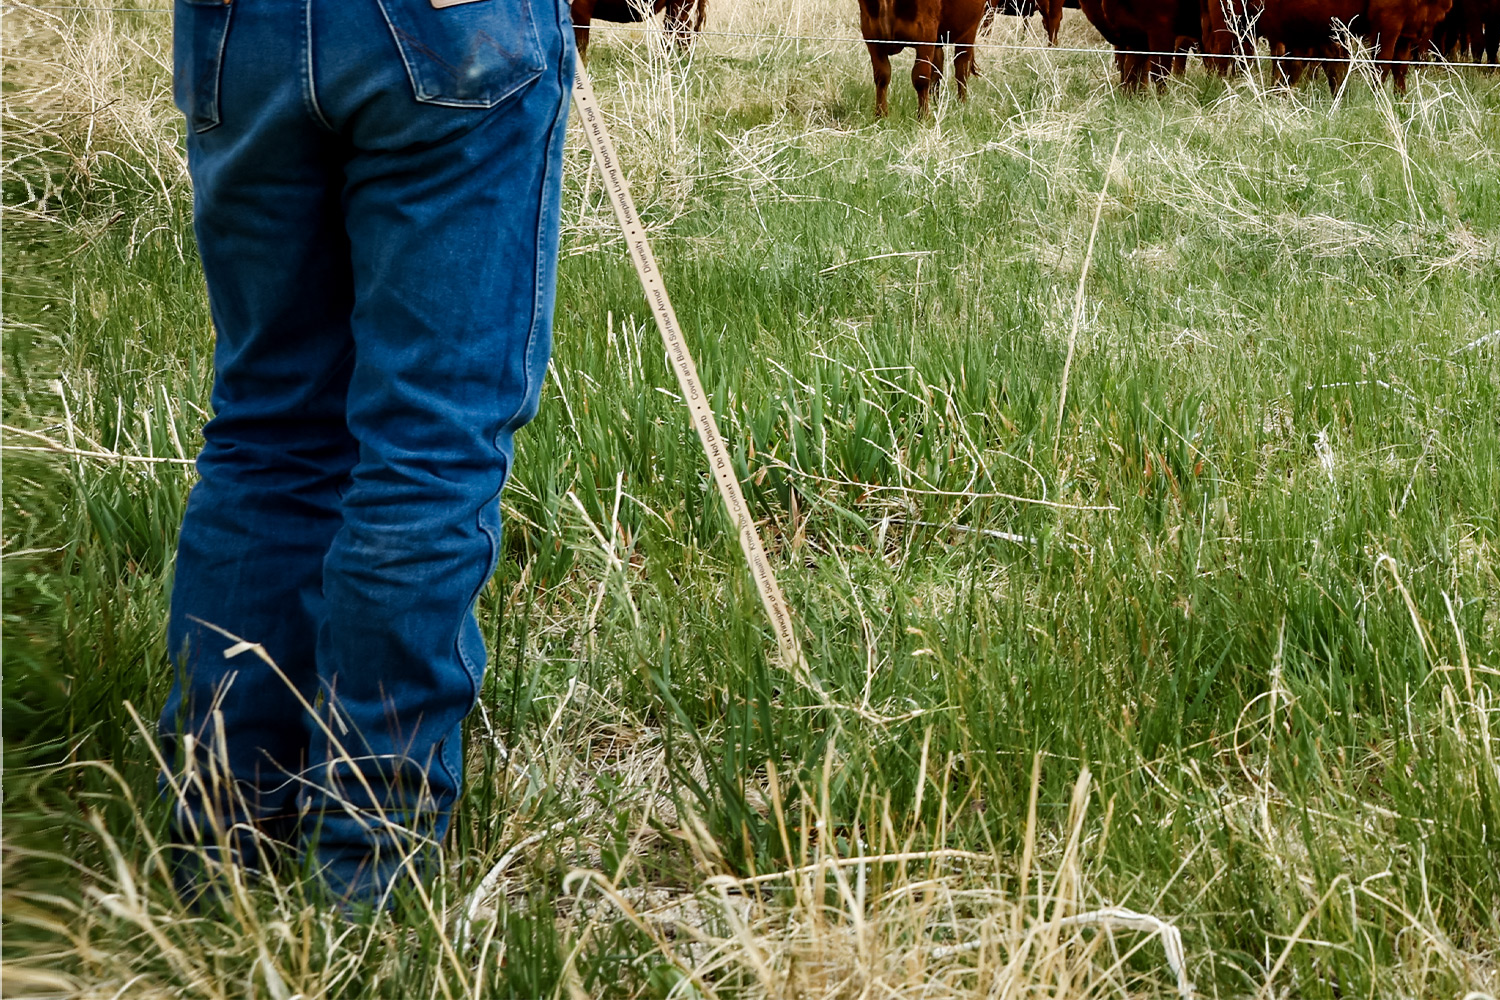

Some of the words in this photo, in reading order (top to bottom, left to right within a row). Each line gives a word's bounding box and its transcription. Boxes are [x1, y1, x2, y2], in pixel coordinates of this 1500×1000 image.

[584, 106, 595, 122] Soil
[591, 122, 600, 135] the
[597, 136, 604, 145] in
[600, 145, 612, 168] Roots
[608, 168, 621, 192] Living
[617, 192, 632, 224] Keeping
[635, 240, 651, 273] Diversity
[652, 289, 665, 310] Armor
[661, 312, 676, 341] Surface
[671, 341, 684, 361] Build
[679, 362, 690, 376] and
[686, 378, 698, 400] Cover
[700, 415, 714, 442] Disturb
[710, 442, 720, 456] Not
[716, 457, 724, 469] Do
[725, 483, 740, 511] Context
[745, 530, 756, 551] Know
[762, 579, 772, 594] Soil
[768, 594, 776, 602] of
[772, 602, 789, 637] Principles
